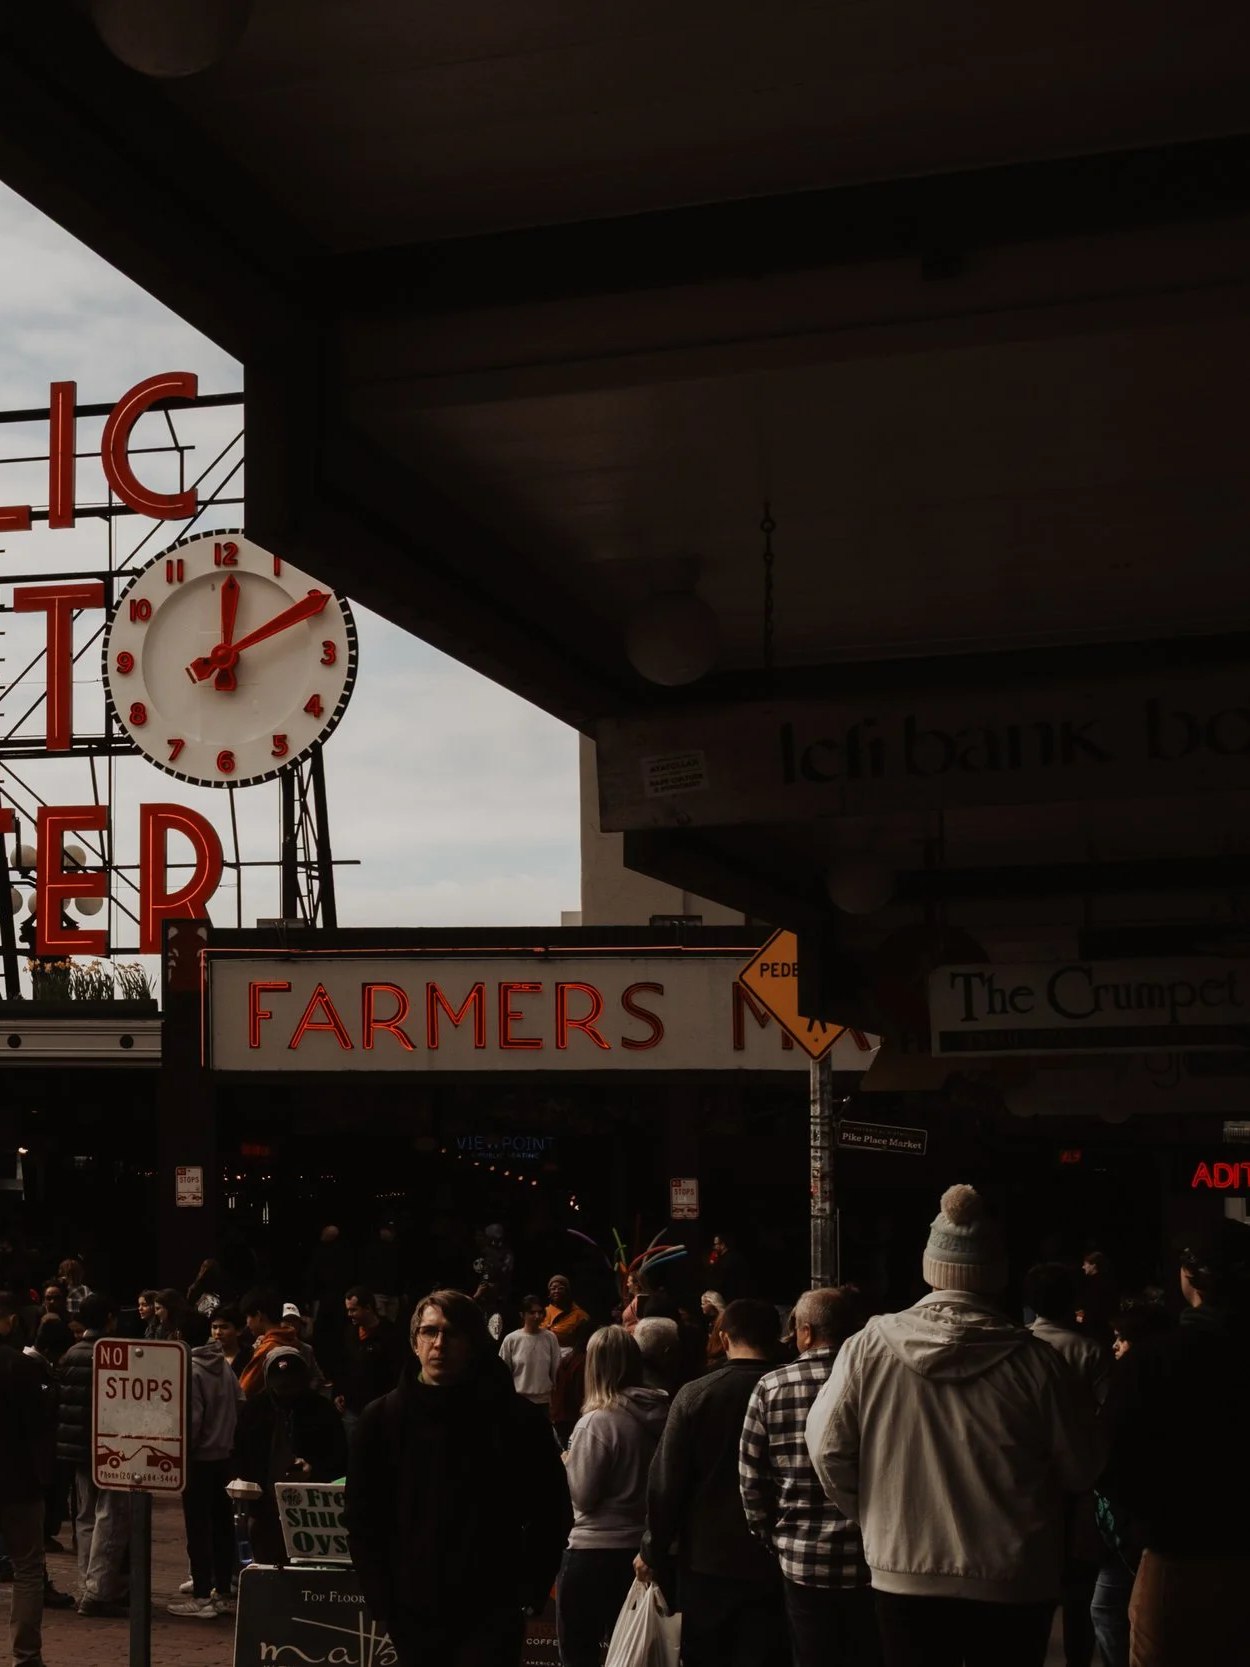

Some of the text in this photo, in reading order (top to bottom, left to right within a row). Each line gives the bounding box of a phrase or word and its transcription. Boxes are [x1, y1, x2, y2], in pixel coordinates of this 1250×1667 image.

[214, 542, 238, 566] 12
[166, 559, 184, 583] 11
[130, 598, 151, 623] 10
[116, 651, 134, 674] 9
[320, 640, 337, 666] 3
[129, 702, 147, 726] 8
[303, 694, 324, 718] 4
[167, 738, 185, 761] 7
[271, 734, 289, 757] 5
[903, 714, 1113, 777] bank
[216, 750, 235, 774] 6
[950, 965, 1245, 1024] The Crumpet
[248, 981, 665, 1051] FARMERS
[841, 1132, 922, 1149] Pike Place Market
[100, 1345, 123, 1366] NO
[105, 1376, 172, 1402] STOPS
[301, 1590, 367, 1604] TOP FLOOR
